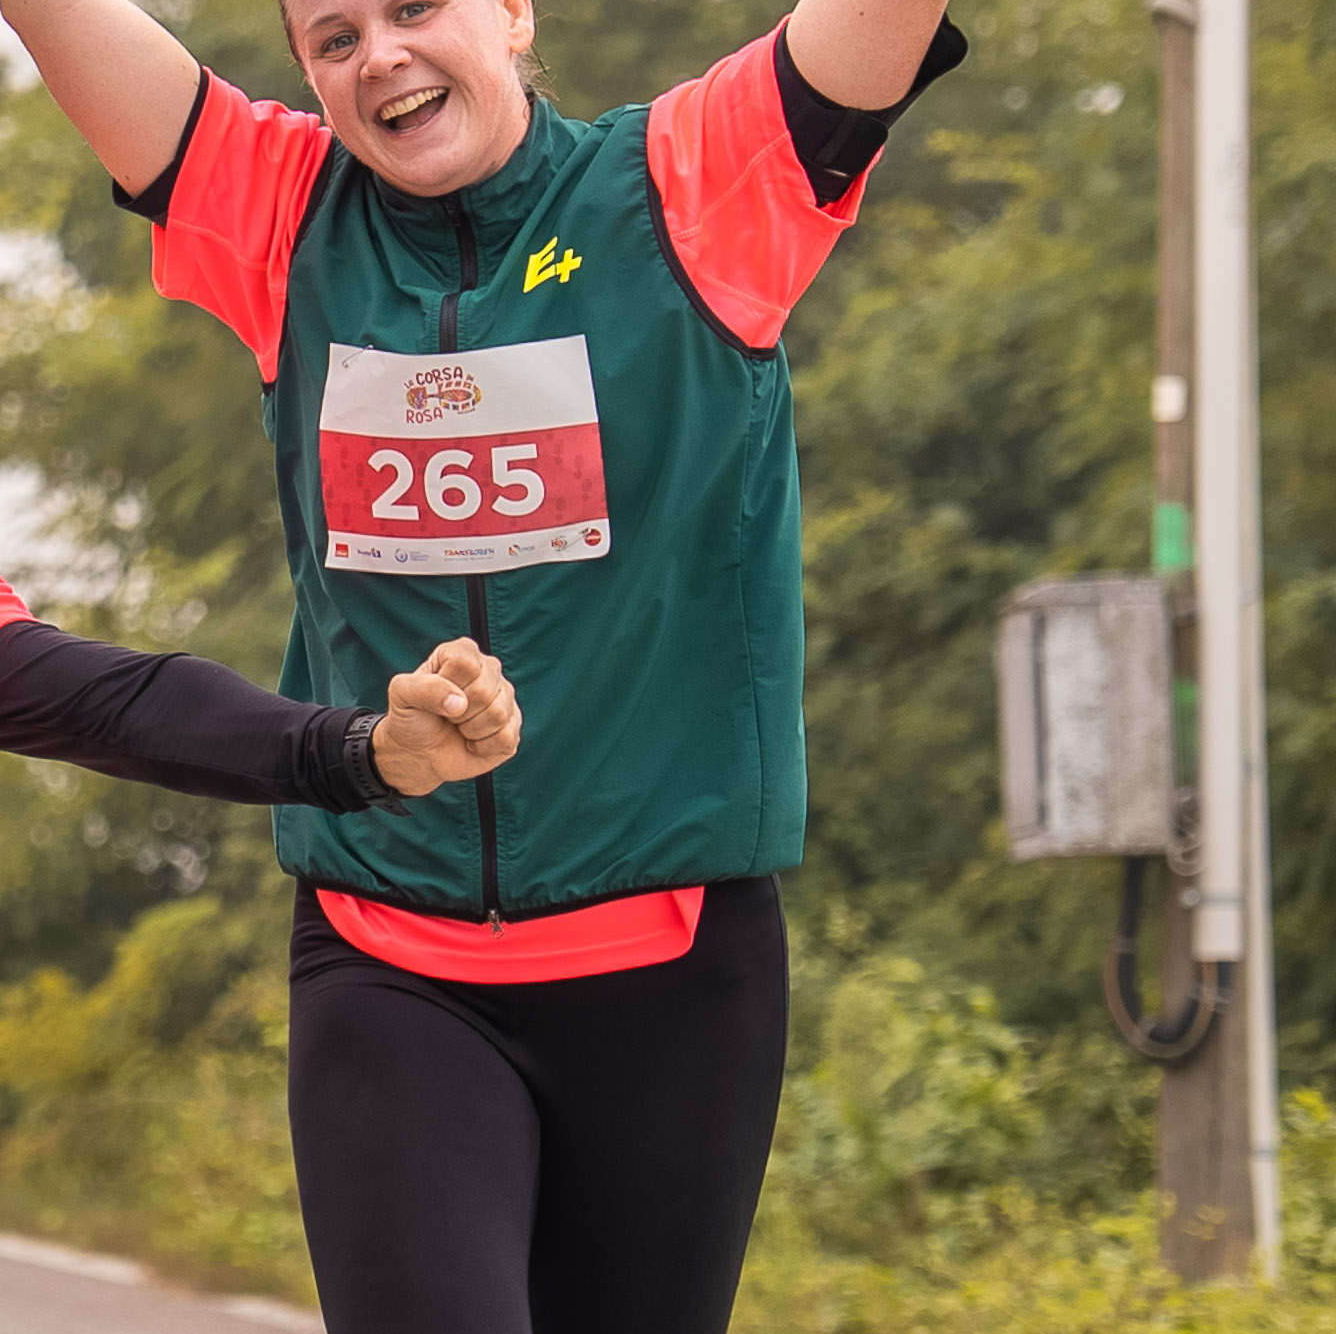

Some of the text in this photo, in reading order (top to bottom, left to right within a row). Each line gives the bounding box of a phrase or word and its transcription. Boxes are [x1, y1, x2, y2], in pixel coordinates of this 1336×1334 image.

[416, 366, 463, 385] CORSA
[406, 407, 443, 424] ROSA
[367, 443, 545, 521] 265
